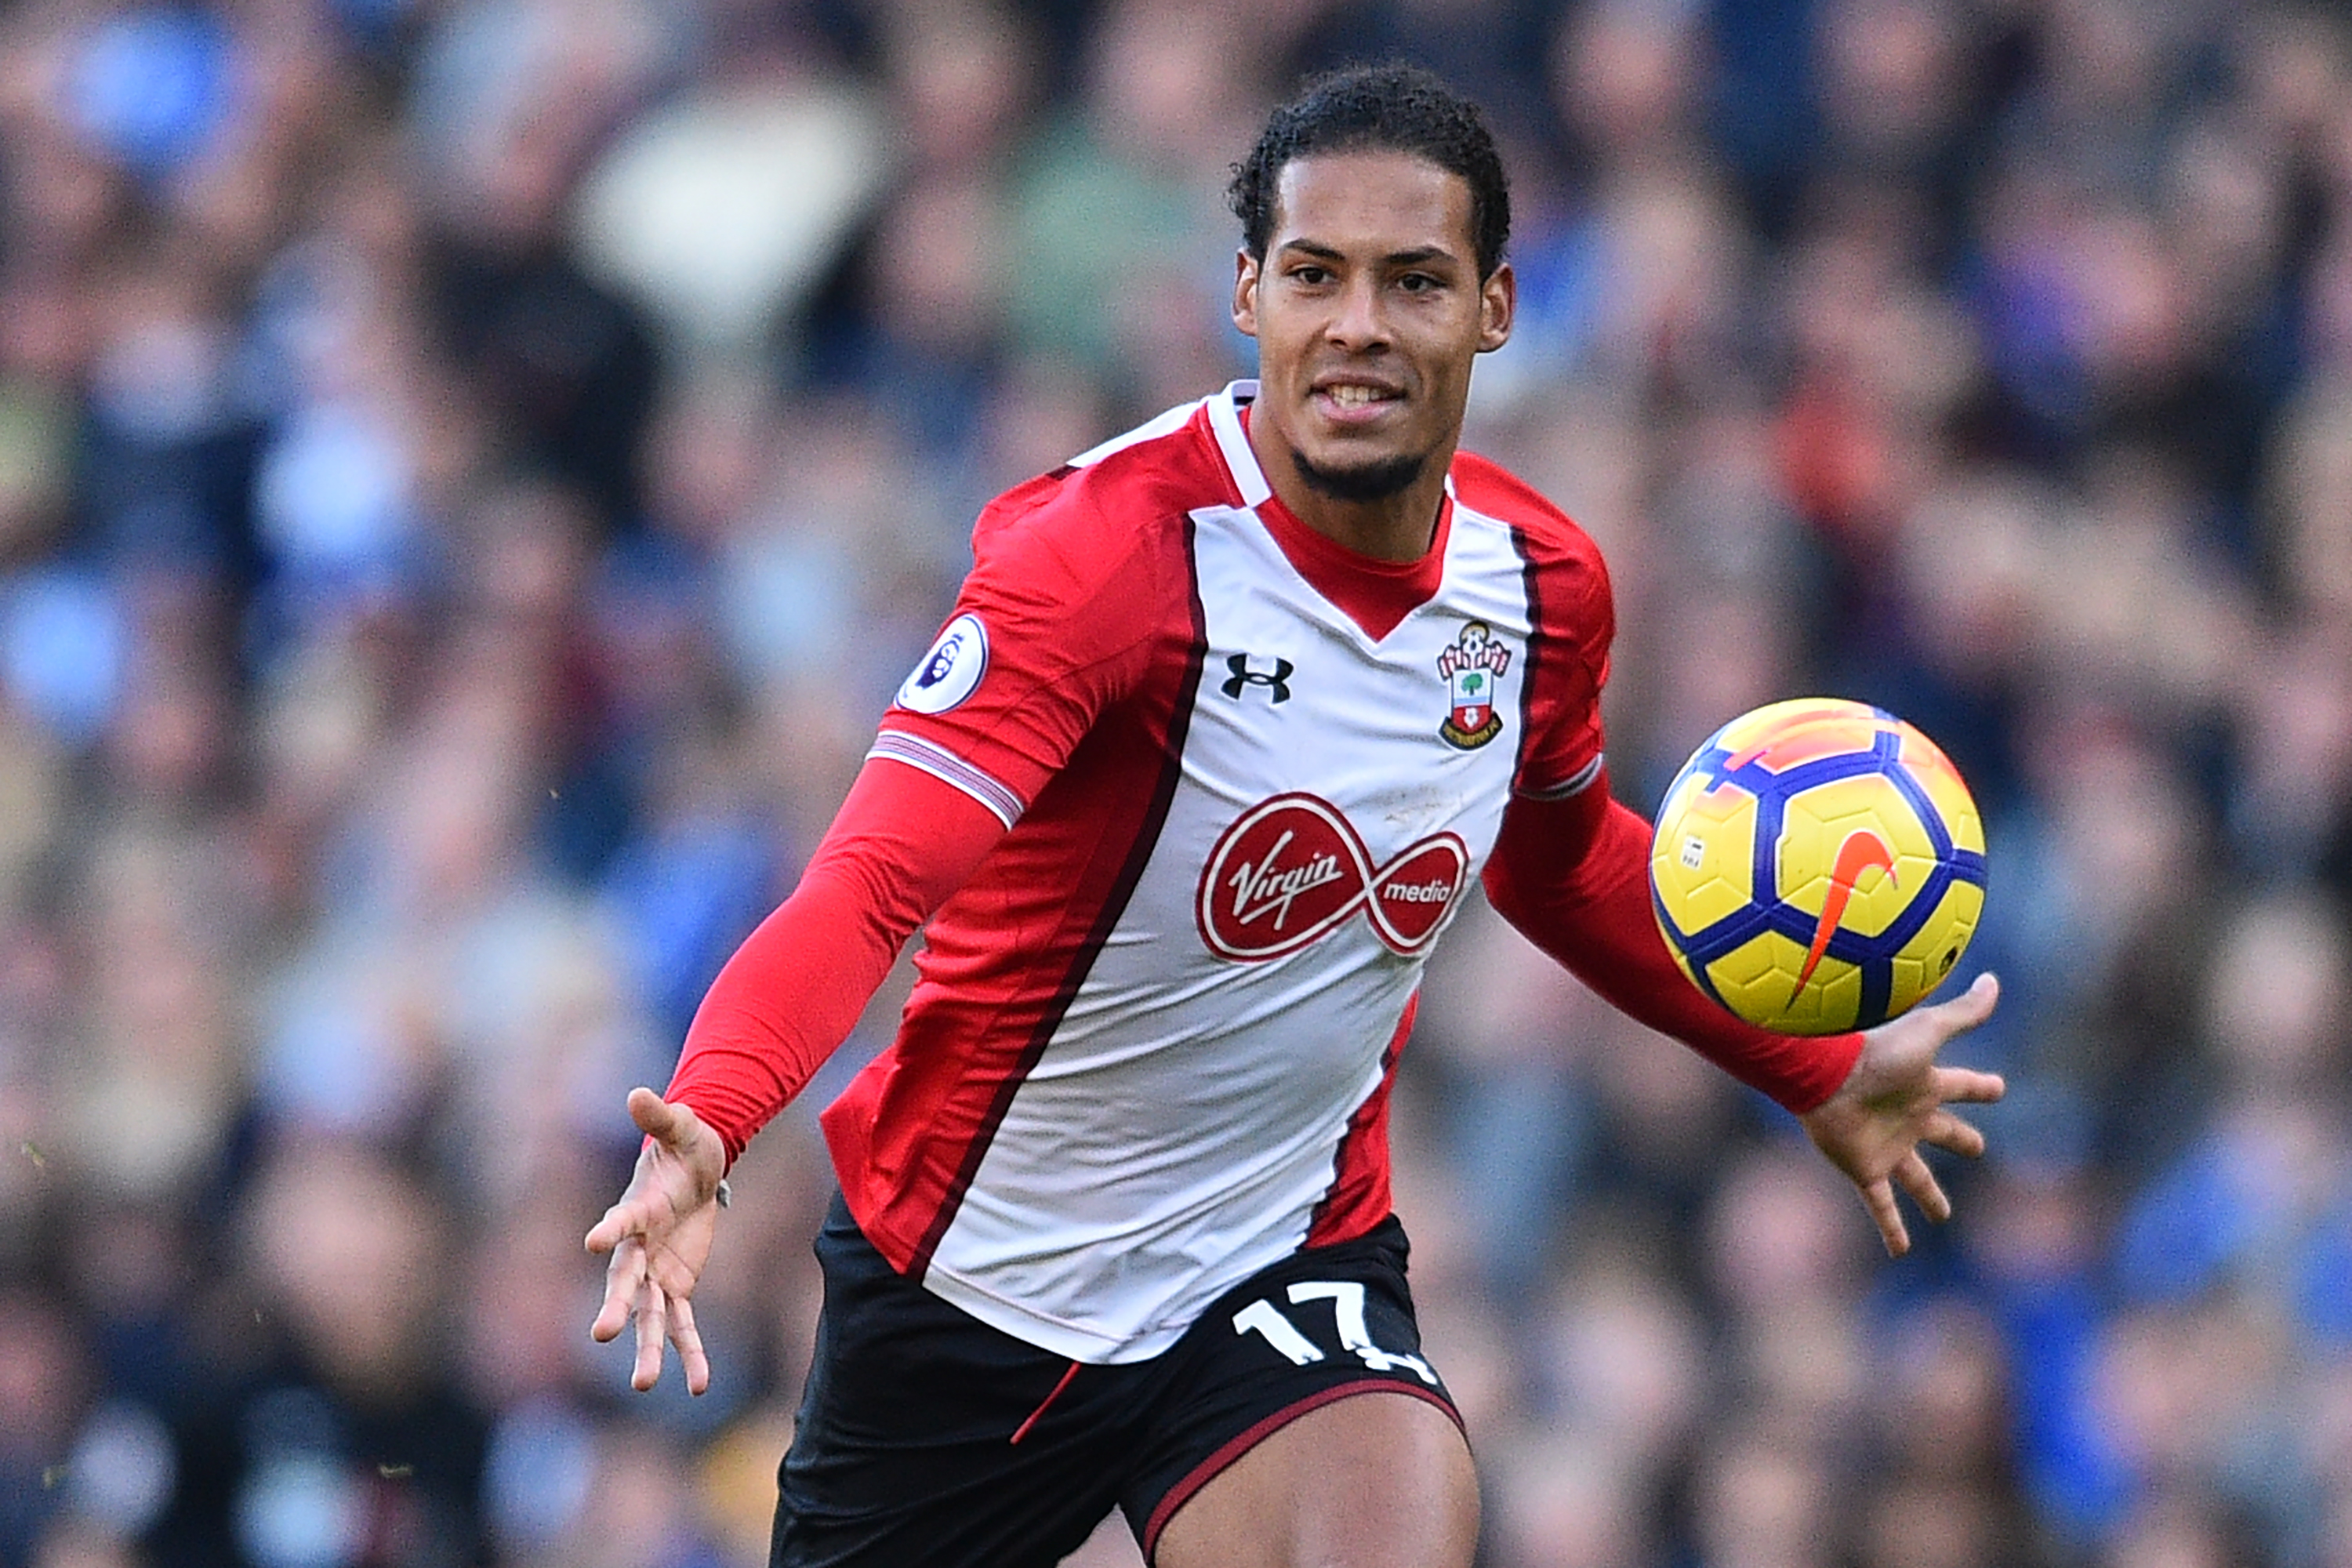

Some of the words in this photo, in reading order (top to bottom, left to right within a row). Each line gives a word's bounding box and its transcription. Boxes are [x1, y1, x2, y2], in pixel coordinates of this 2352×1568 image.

[1228, 829, 1344, 931] Virgin
[1383, 879, 1453, 902] media
[1232, 1281, 1371, 1366] 17
